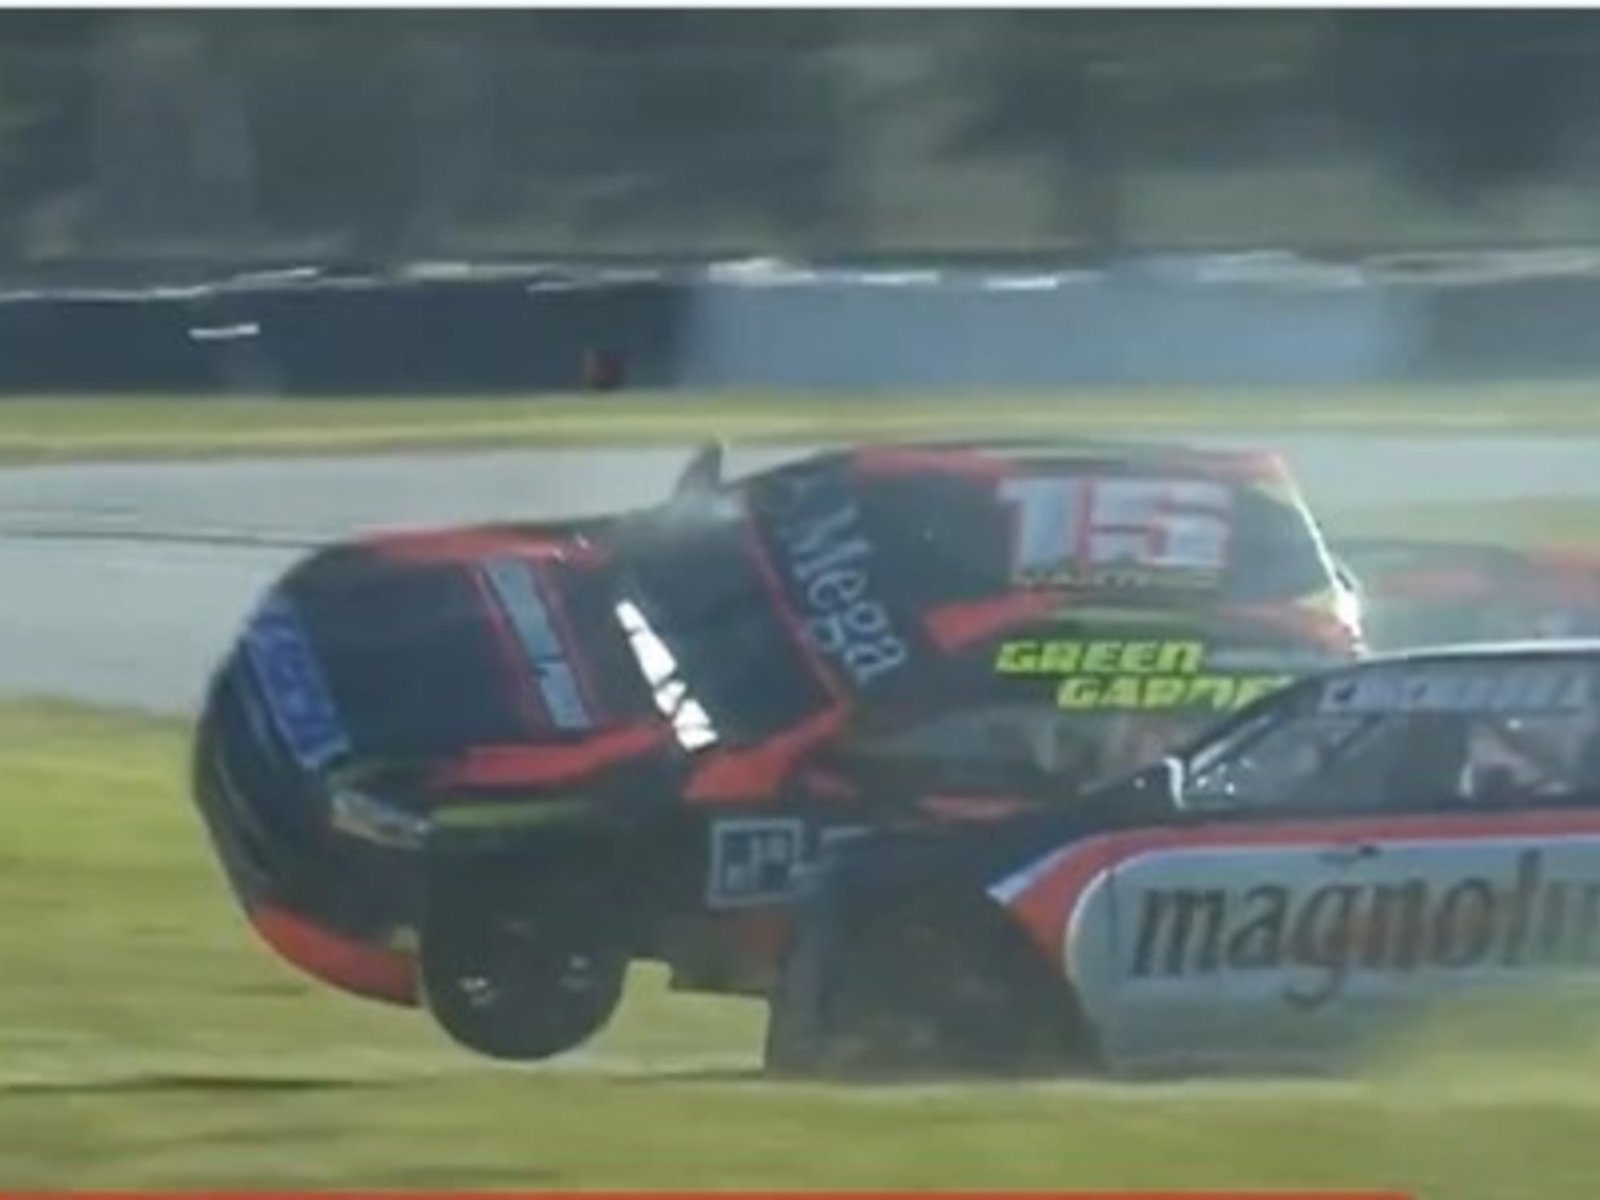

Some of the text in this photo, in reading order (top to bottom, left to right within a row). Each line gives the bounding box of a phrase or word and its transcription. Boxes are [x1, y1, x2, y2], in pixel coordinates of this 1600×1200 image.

[997, 477, 1232, 570] 15
[786, 500, 908, 686] Mega
[997, 640, 1204, 674] GREEN
